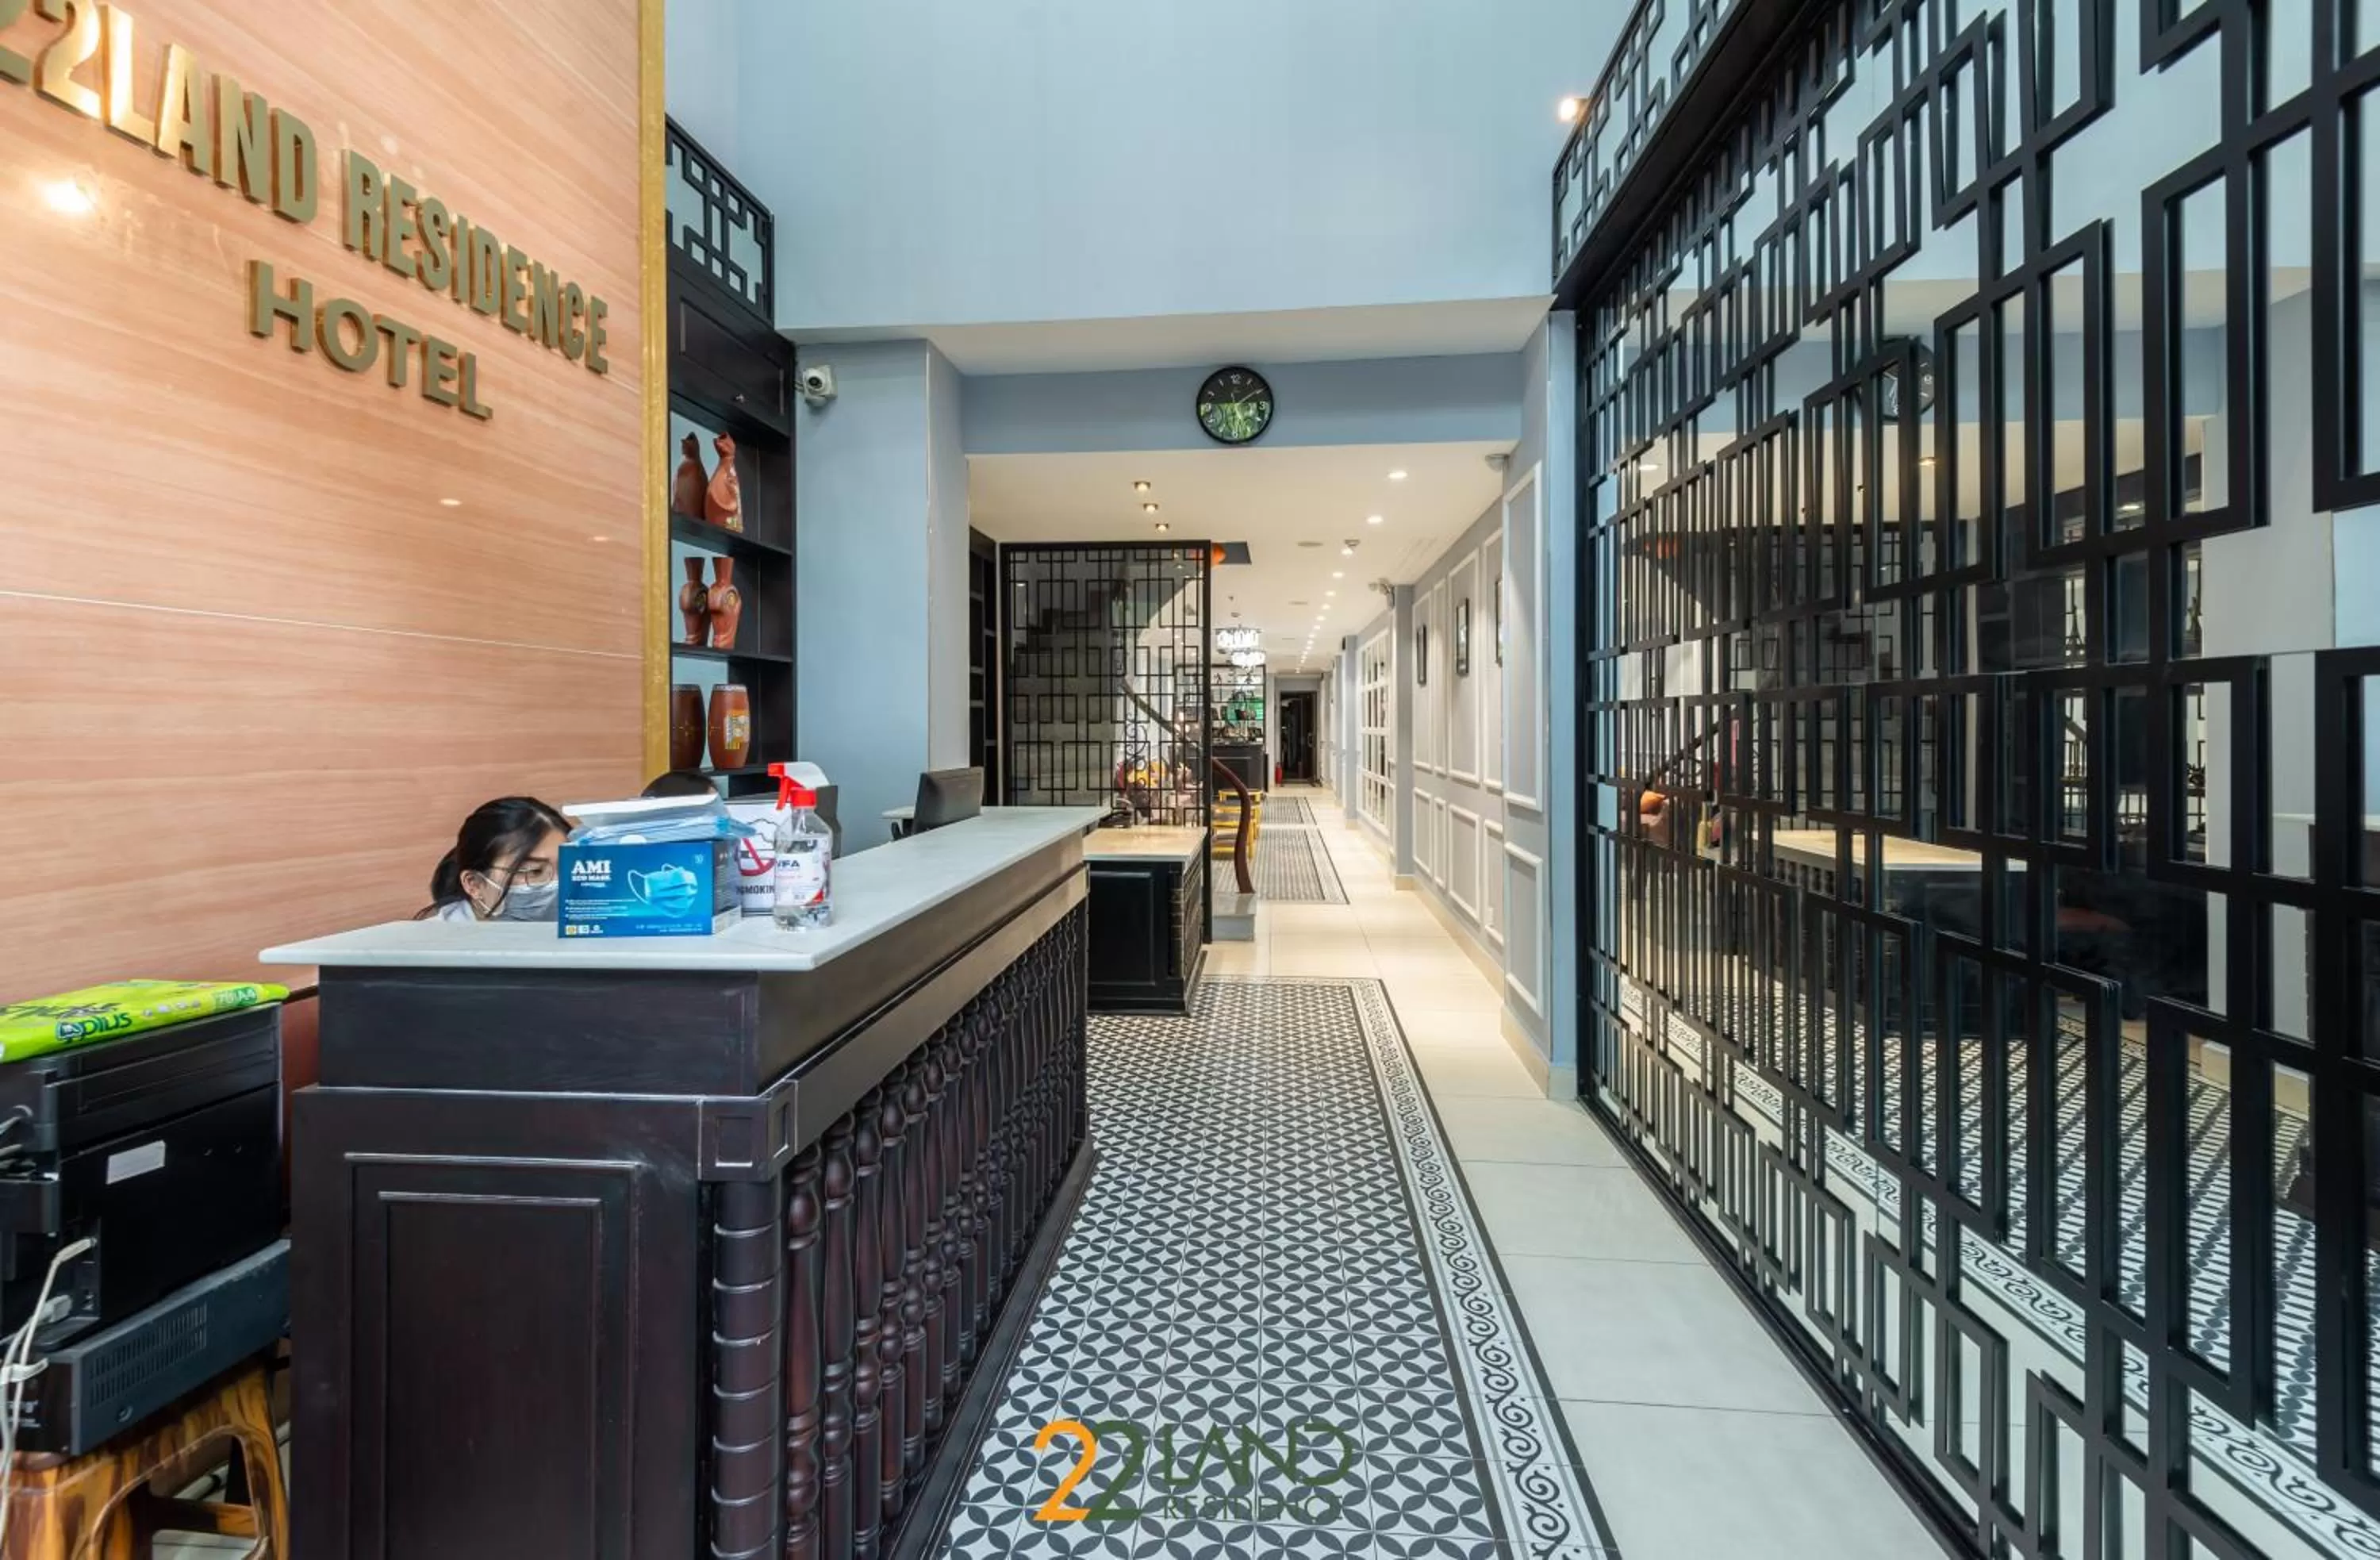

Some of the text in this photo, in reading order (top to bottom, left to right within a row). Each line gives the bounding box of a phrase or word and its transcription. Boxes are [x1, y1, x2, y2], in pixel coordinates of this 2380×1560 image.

[341, 148, 609, 375] RESIDENCE
[246, 259, 493, 421] HOTEL
[571, 859, 612, 874] AMI
[739, 885, 775, 895] SMOKIN
